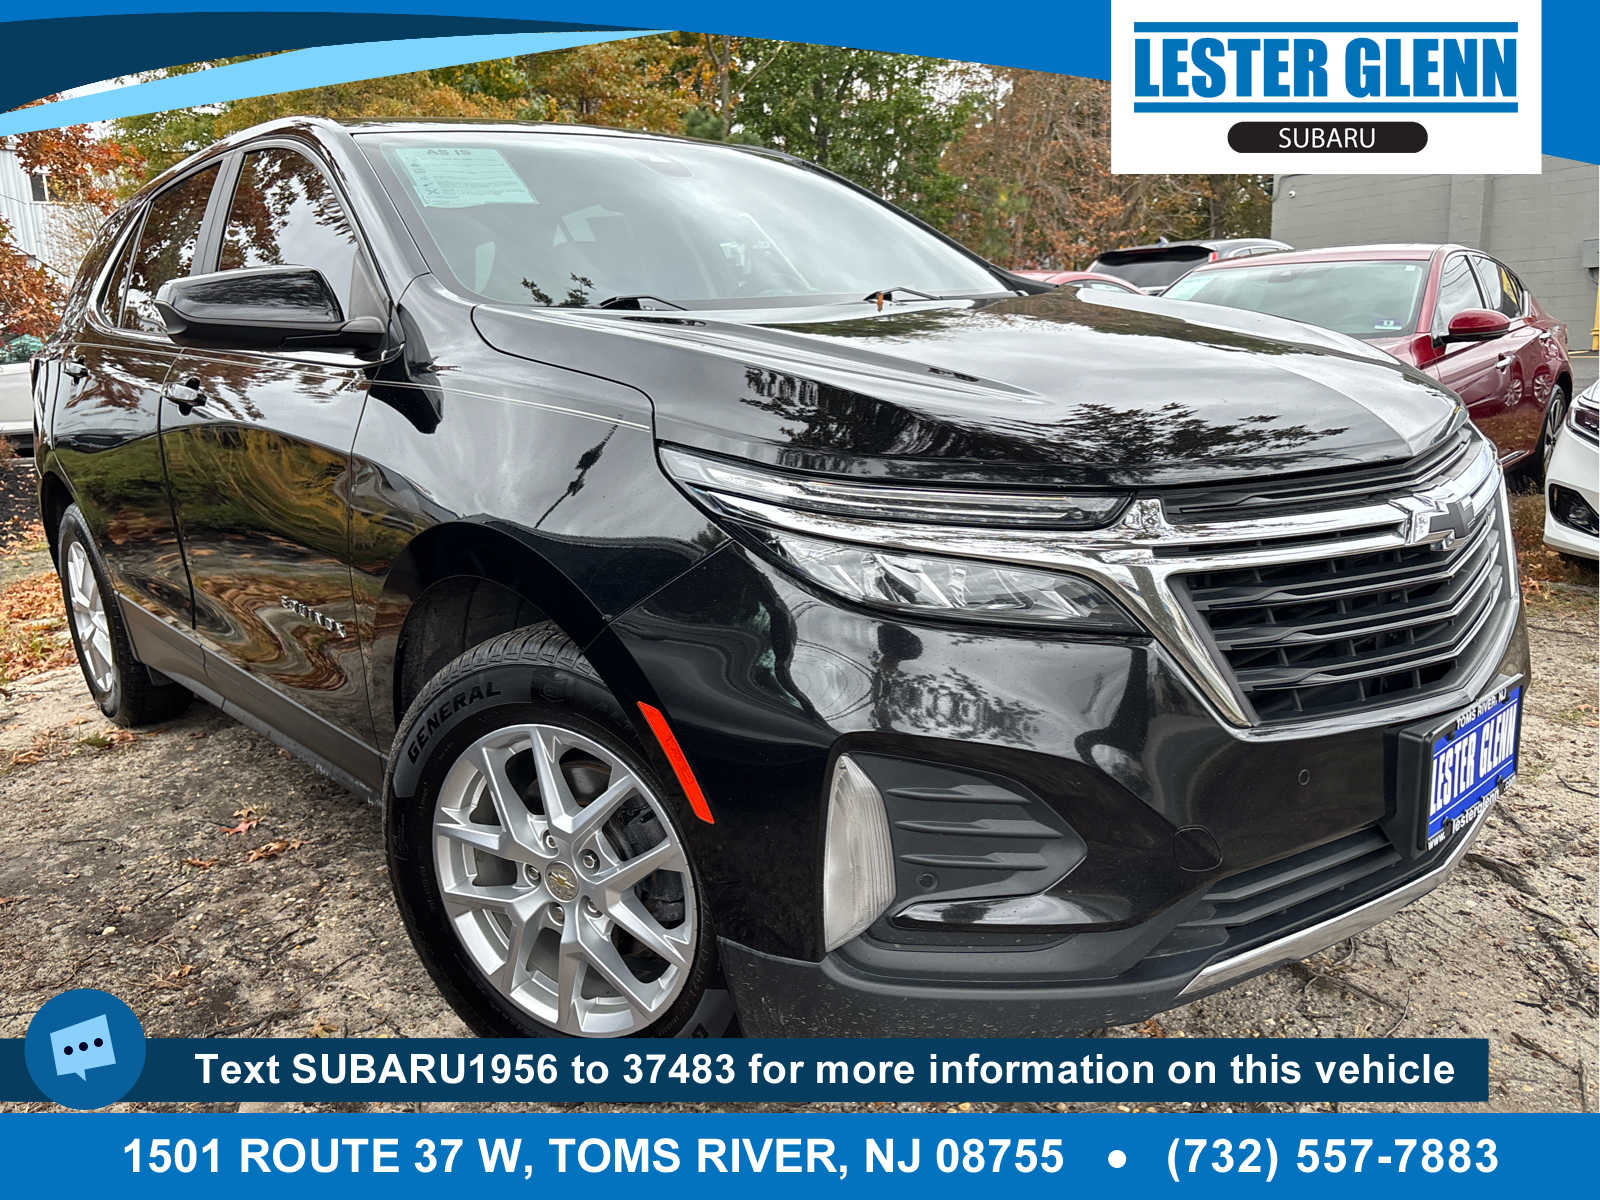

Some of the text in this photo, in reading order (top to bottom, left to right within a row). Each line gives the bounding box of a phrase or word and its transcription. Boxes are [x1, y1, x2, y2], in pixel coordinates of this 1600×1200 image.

[407, 682, 502, 765] GENERAL
[1429, 702, 1518, 817] LESTER GLENN
[1456, 708, 1477, 730] TOMS
